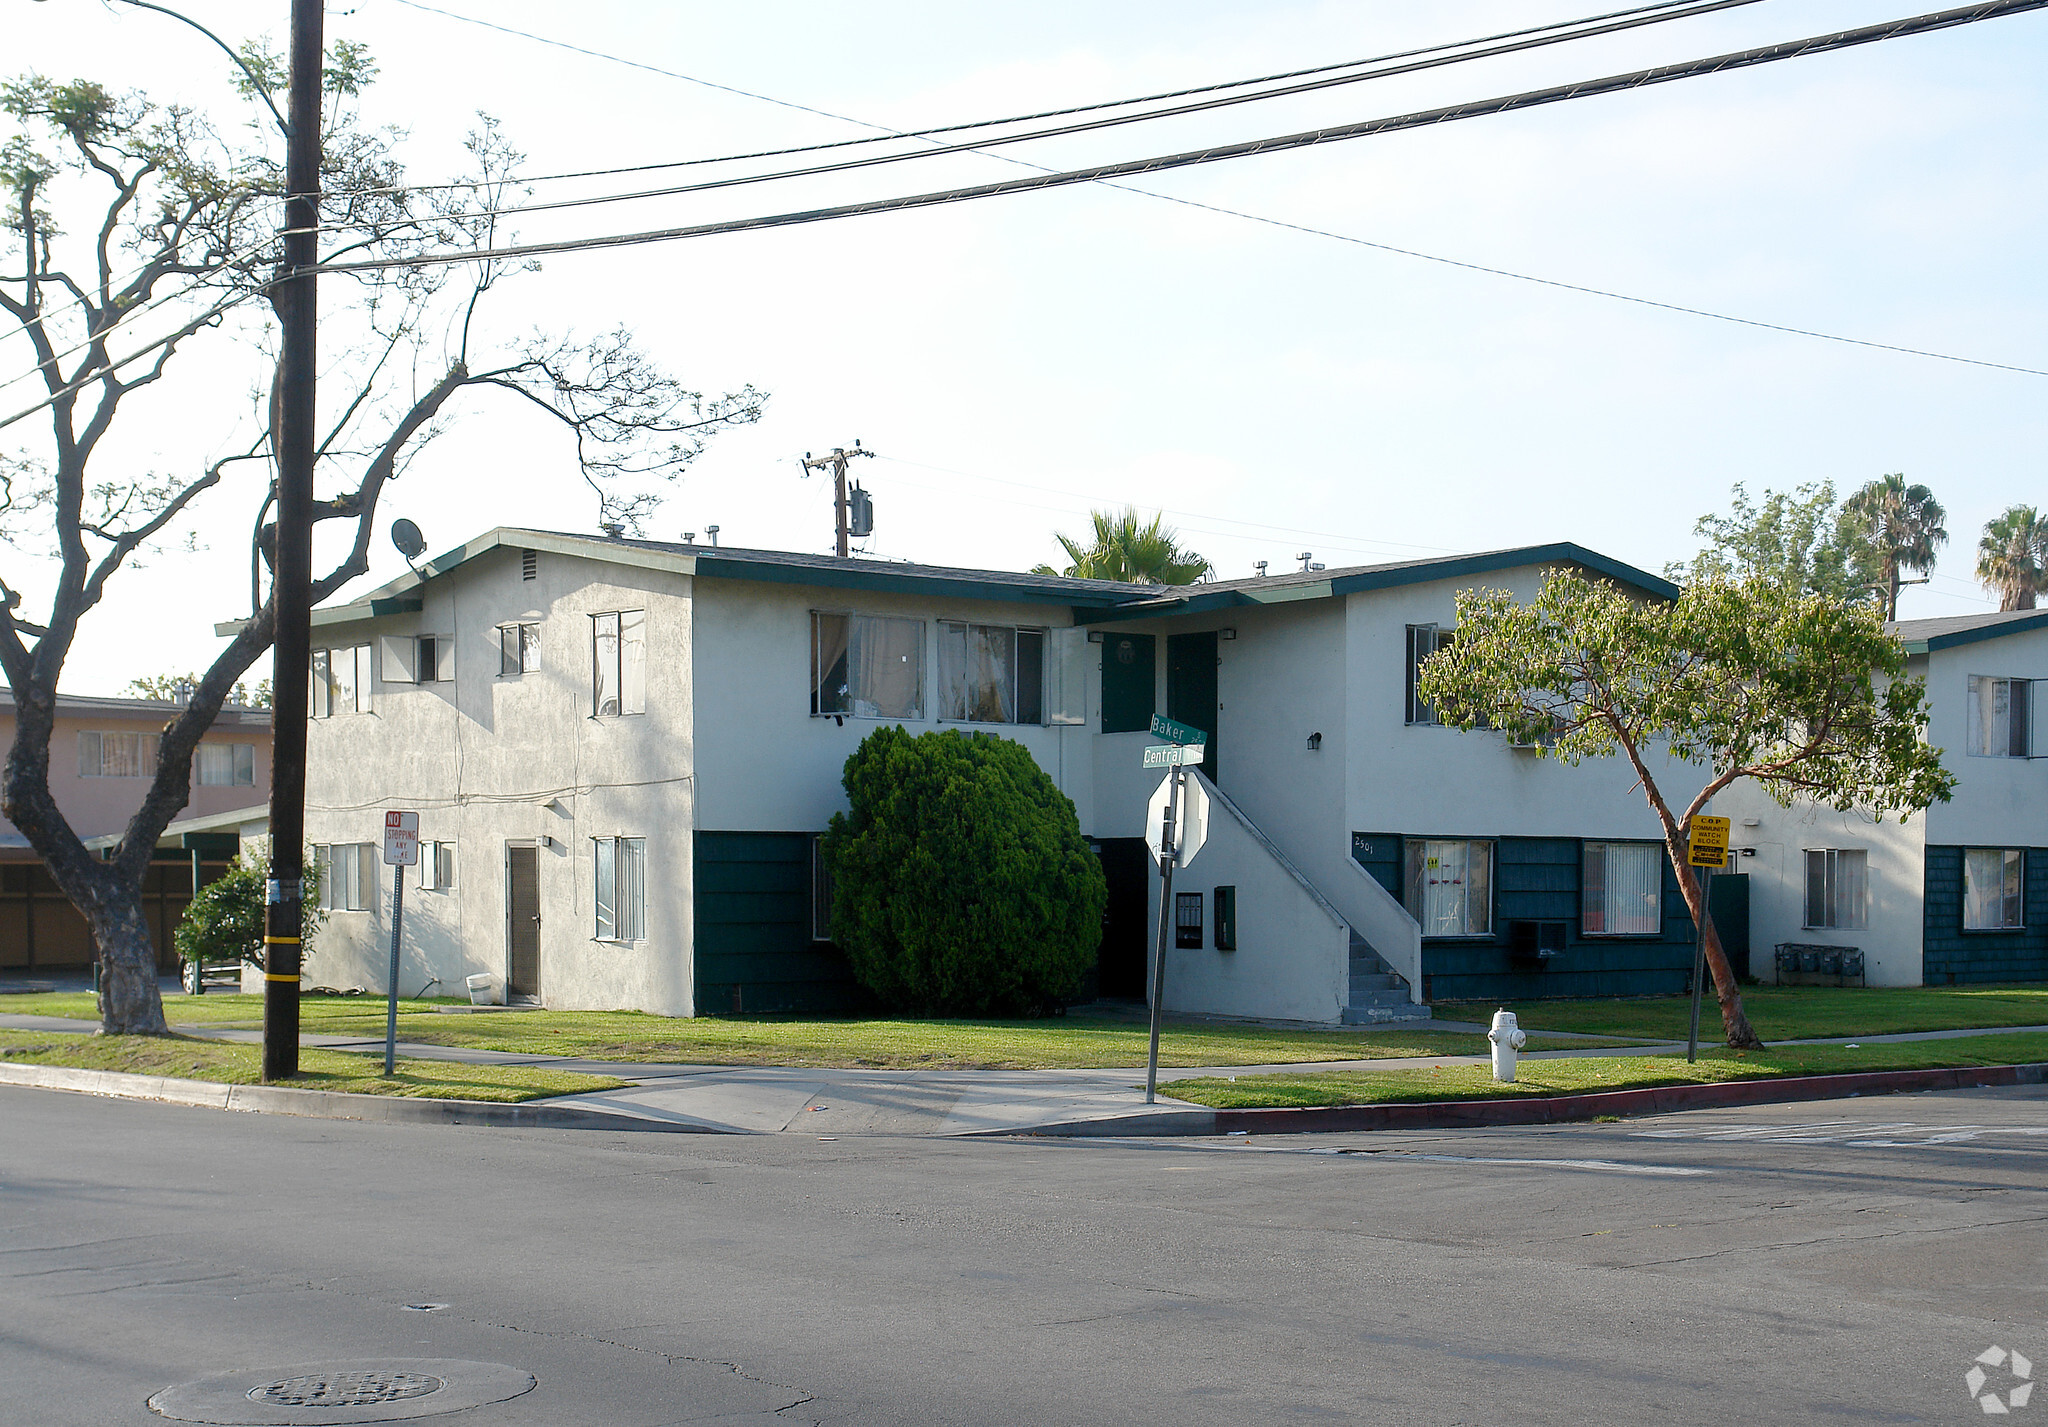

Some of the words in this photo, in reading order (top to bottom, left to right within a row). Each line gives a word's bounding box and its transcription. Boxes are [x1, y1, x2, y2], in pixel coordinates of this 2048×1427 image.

[1153, 717, 1184, 740] Baker
[1144, 748, 1182, 764] Central
[388, 813, 400, 826] NO
[388, 829, 416, 840] STOPPING
[1692, 824, 1728, 832] COMMUNITY
[395, 841, 408, 849] ANY
[1355, 836, 1373, 855] 2501
